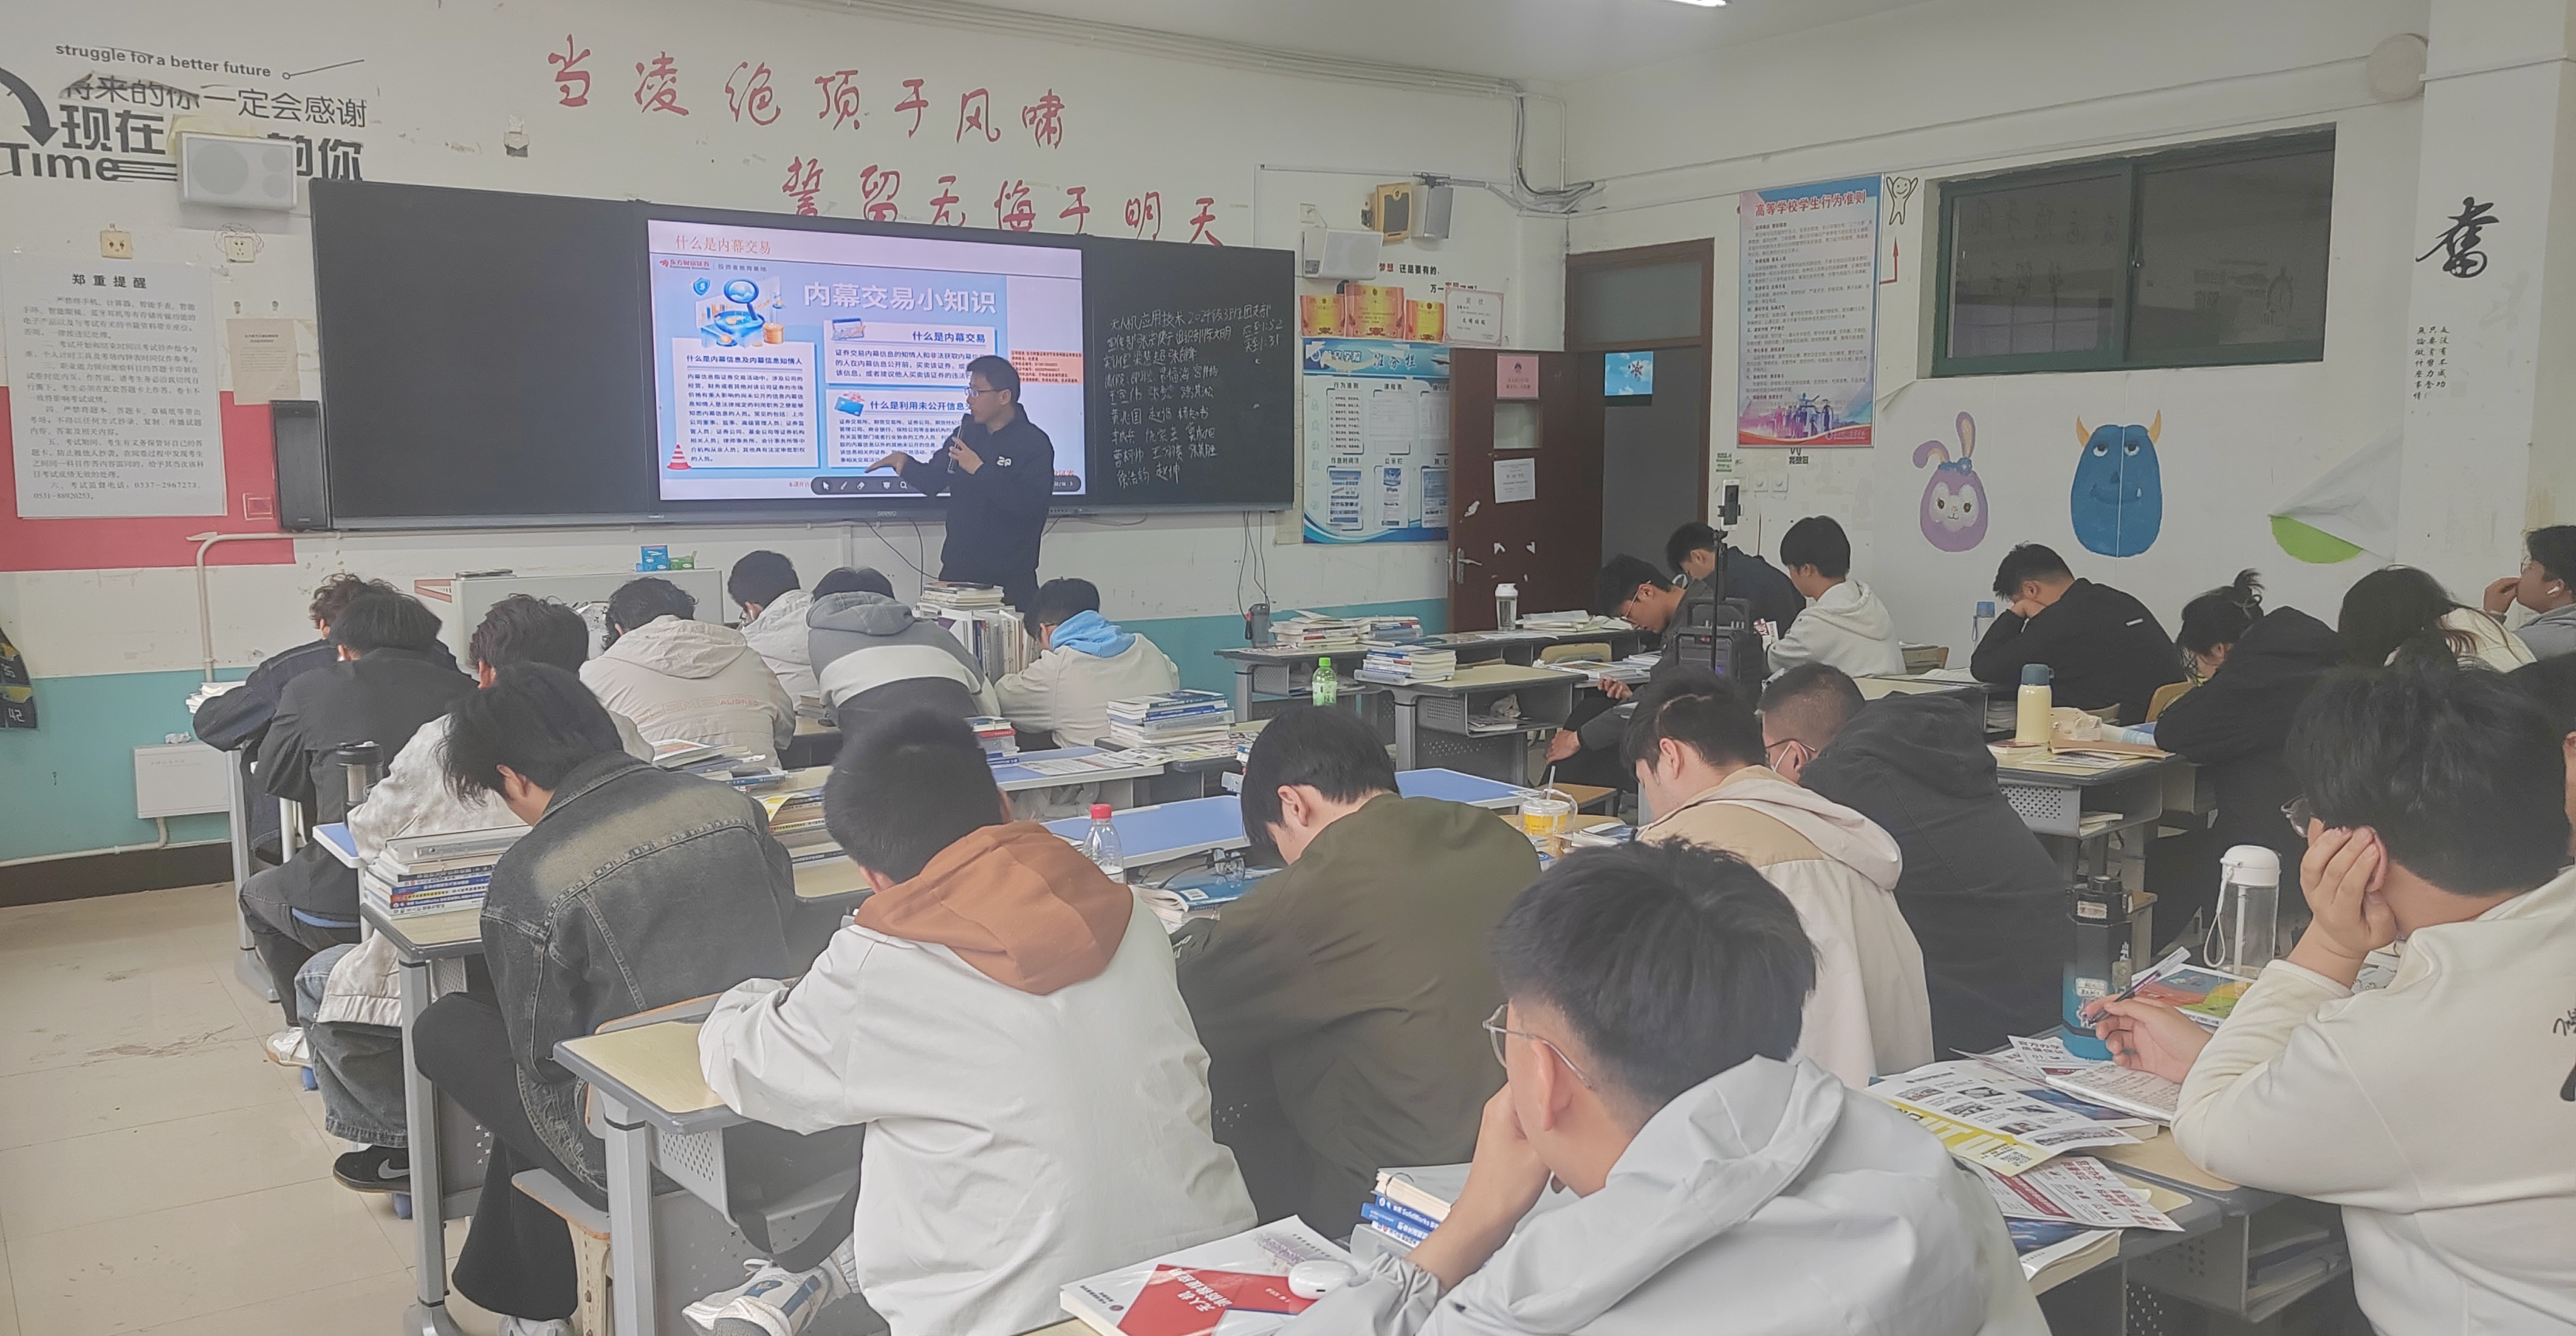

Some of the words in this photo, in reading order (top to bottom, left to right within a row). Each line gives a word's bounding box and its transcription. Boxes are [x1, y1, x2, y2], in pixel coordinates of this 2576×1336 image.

[55, 43, 126, 62] struggle
[130, 50, 153, 65] for
[157, 55, 165, 66] a
[170, 55, 218, 72] better
[223, 60, 271, 78] future
[1755, 189, 1867, 217] 高等学校学生行为准则
[675, 235, 770, 255] 什么是内幕交易
[72, 274, 147, 289] 郑重提醒
[804, 281, 996, 315] 内幕交易小知识
[912, 331, 986, 344] 什么是内幕交易
[686, 355, 802, 365] 什么是内幕信息及内幕信息知情人
[720, 699, 759, 707] ALIGNED
